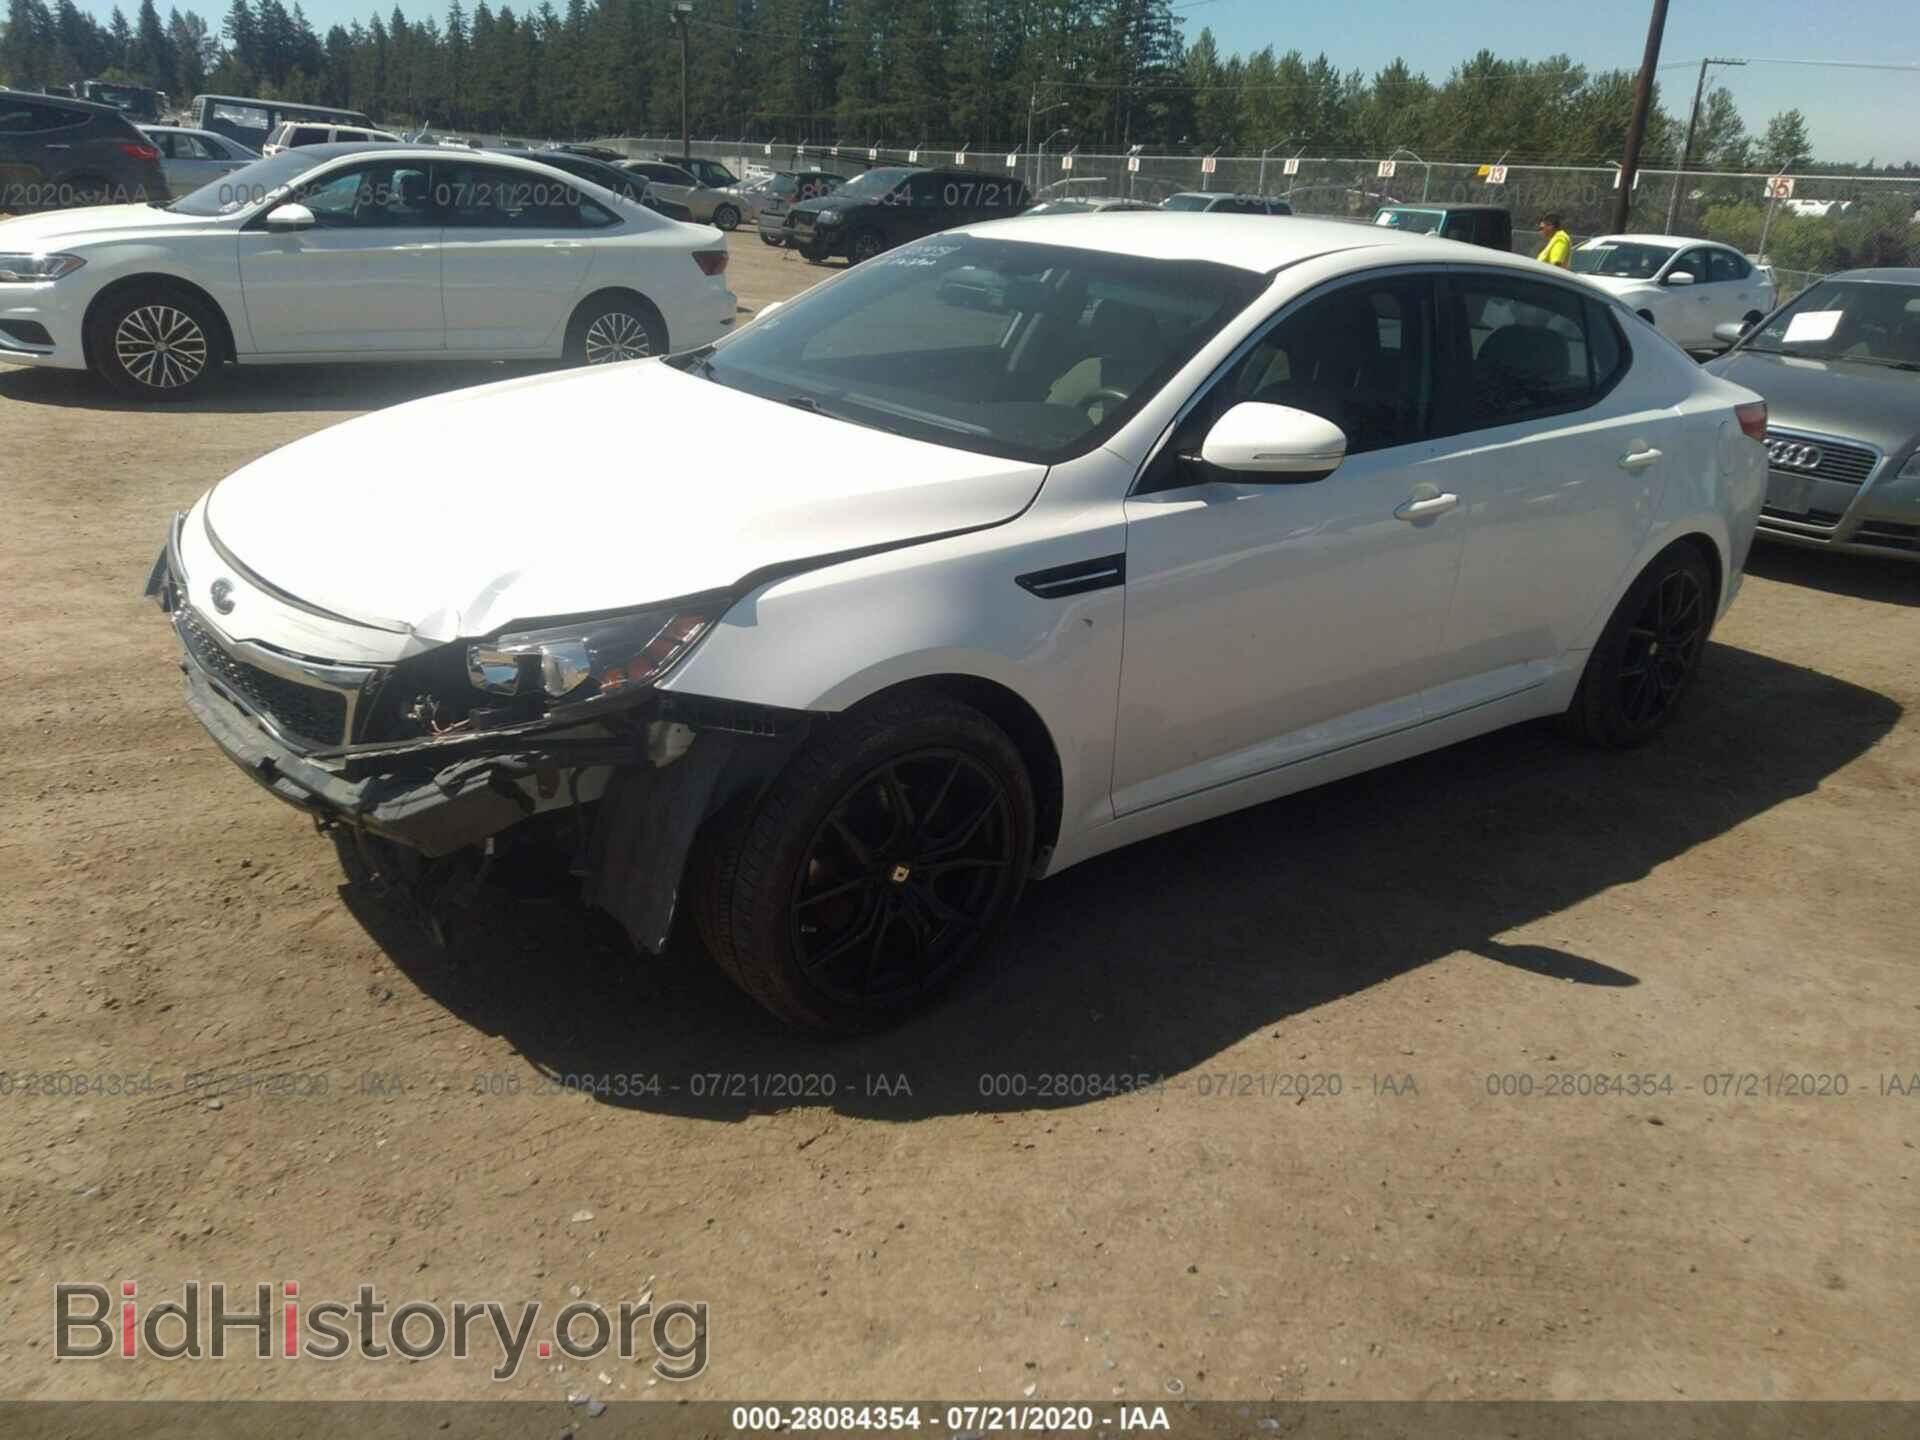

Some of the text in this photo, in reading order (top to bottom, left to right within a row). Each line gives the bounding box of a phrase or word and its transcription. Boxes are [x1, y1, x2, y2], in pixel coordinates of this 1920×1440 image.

[1382, 160, 1393, 175] 12
[1490, 166, 1505, 181] 13
[1770, 178, 1790, 197] 15
